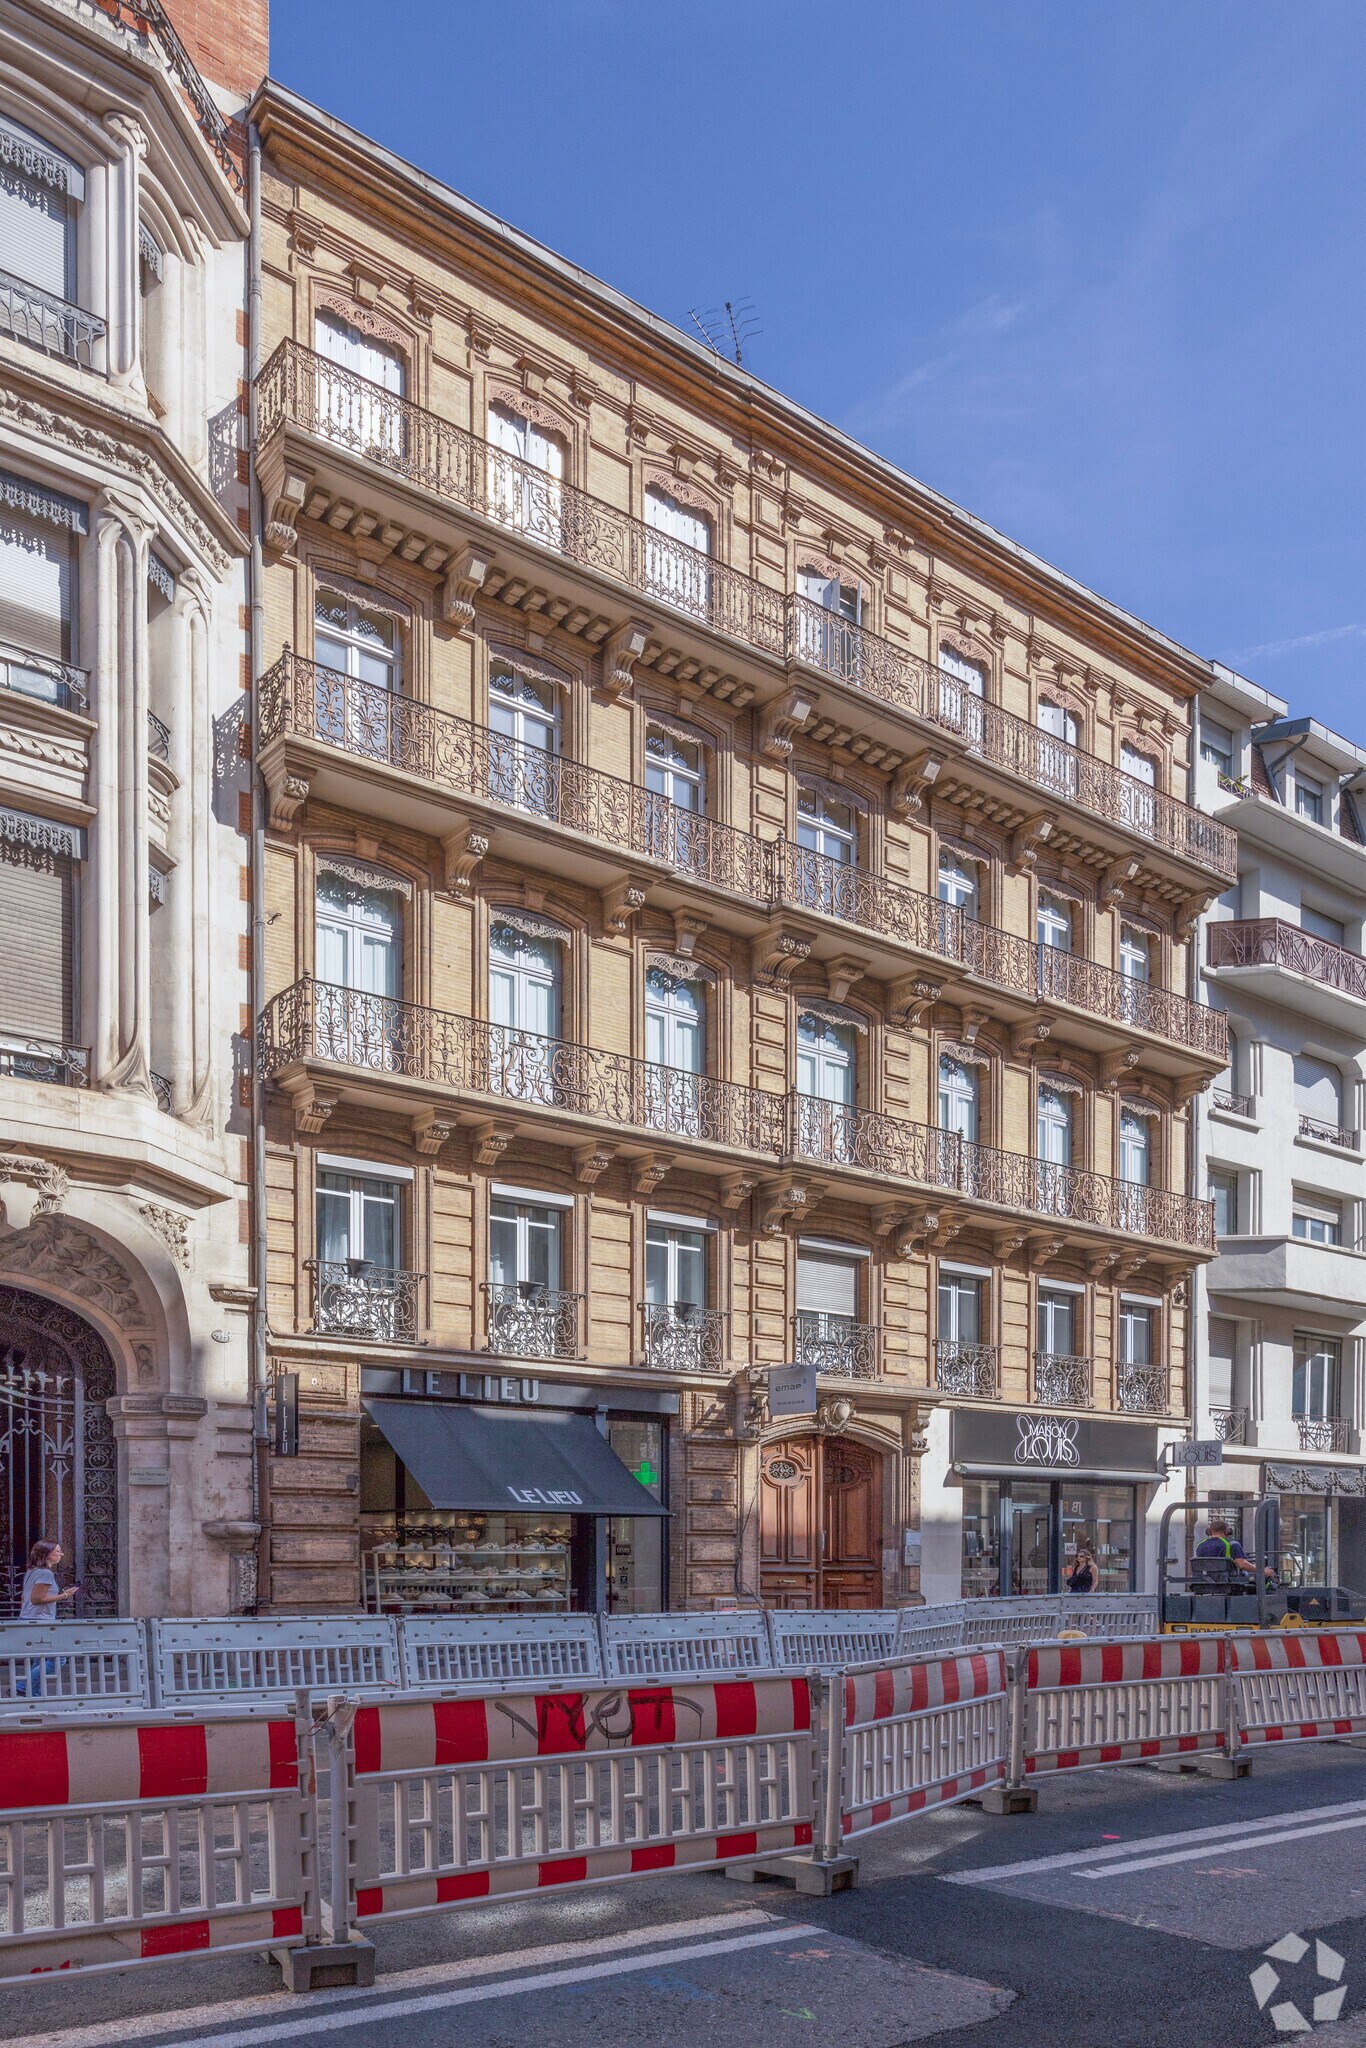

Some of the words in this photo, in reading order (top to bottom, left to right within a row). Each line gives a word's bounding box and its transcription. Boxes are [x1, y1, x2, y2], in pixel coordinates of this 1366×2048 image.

[283, 1377, 288, 1401] LE
[403, 1368, 441, 1395] LE
[460, 1373, 539, 1401] LIEU
[1029, 1424, 1068, 1439] MAISON
[1024, 1435, 1073, 1461] LOUIS
[1178, 1450, 1217, 1463] LOUIS
[1182, 1444, 1213, 1452] MAISON
[507, 1486, 541, 1503] LE
[533, 1488, 583, 1504] LIEU
